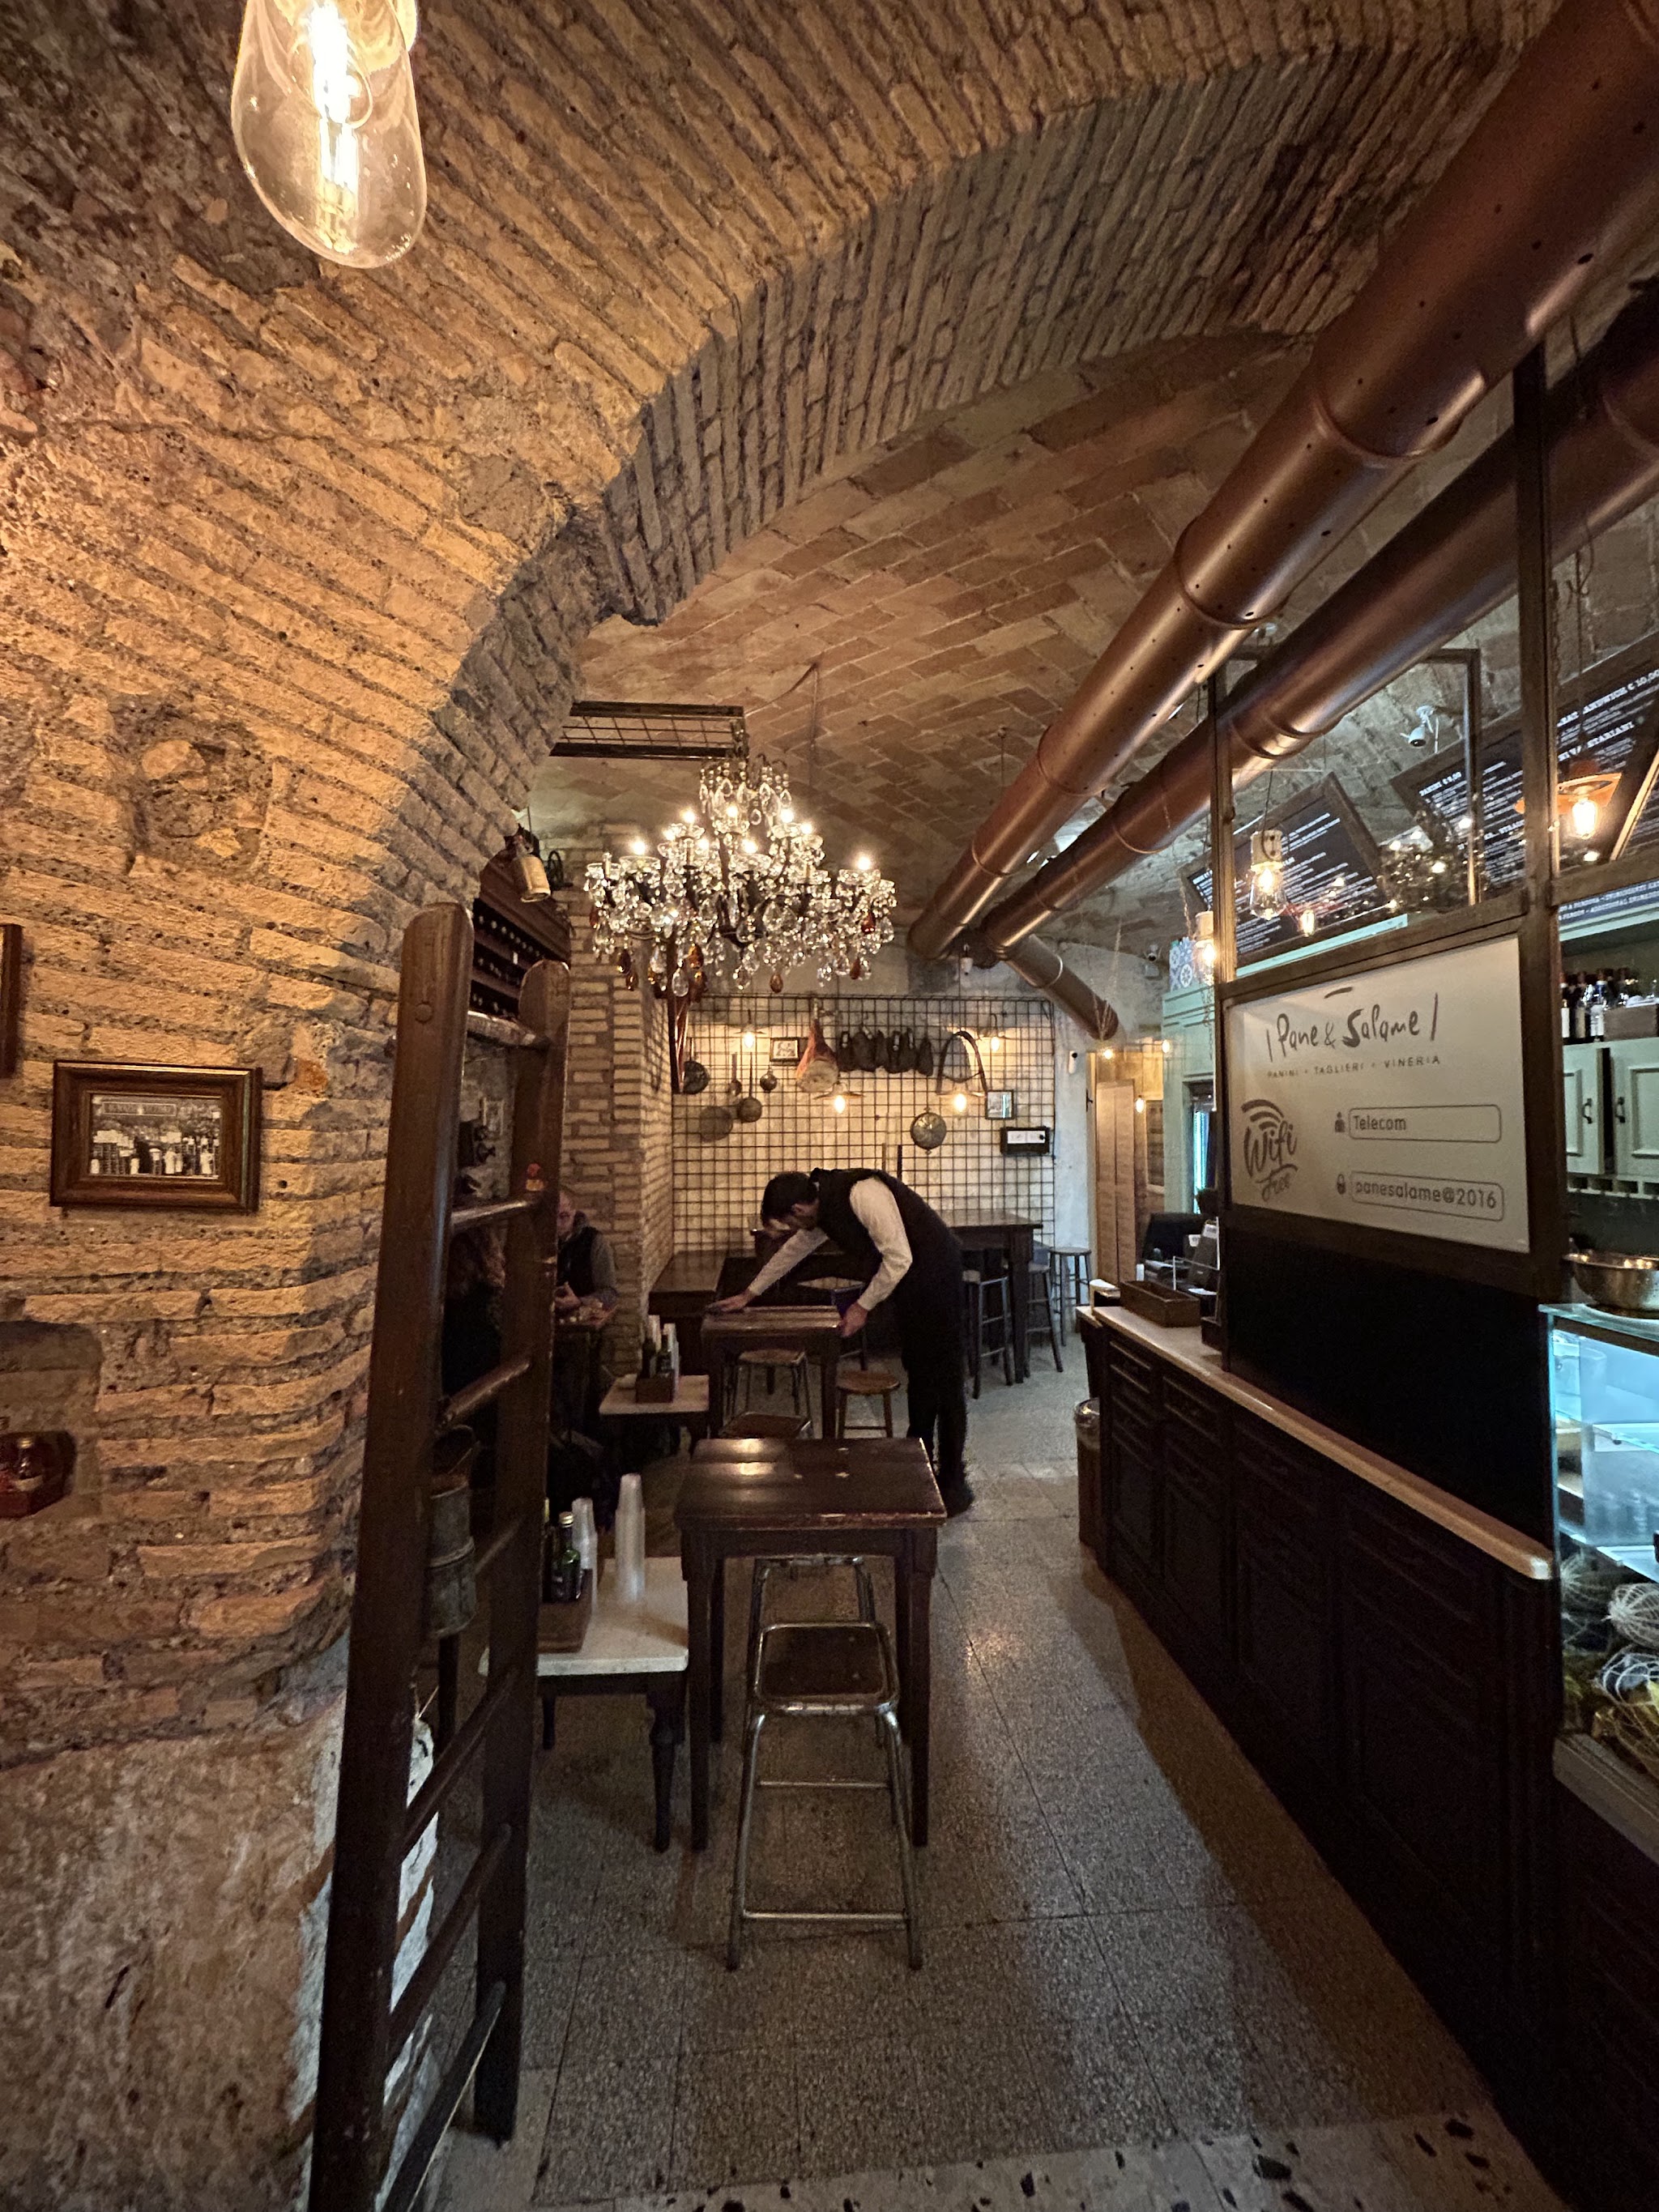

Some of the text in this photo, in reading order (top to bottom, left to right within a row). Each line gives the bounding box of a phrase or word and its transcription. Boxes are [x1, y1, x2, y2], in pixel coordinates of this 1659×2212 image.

[1277, 1004, 1420, 1058] Pane & Salame
[1267, 1055, 1440, 1078] PANINI TAGLIERI VINERIA
[1354, 1115, 1406, 1131] Telecom
[1355, 1180, 1497, 1209] panesalame@2016
